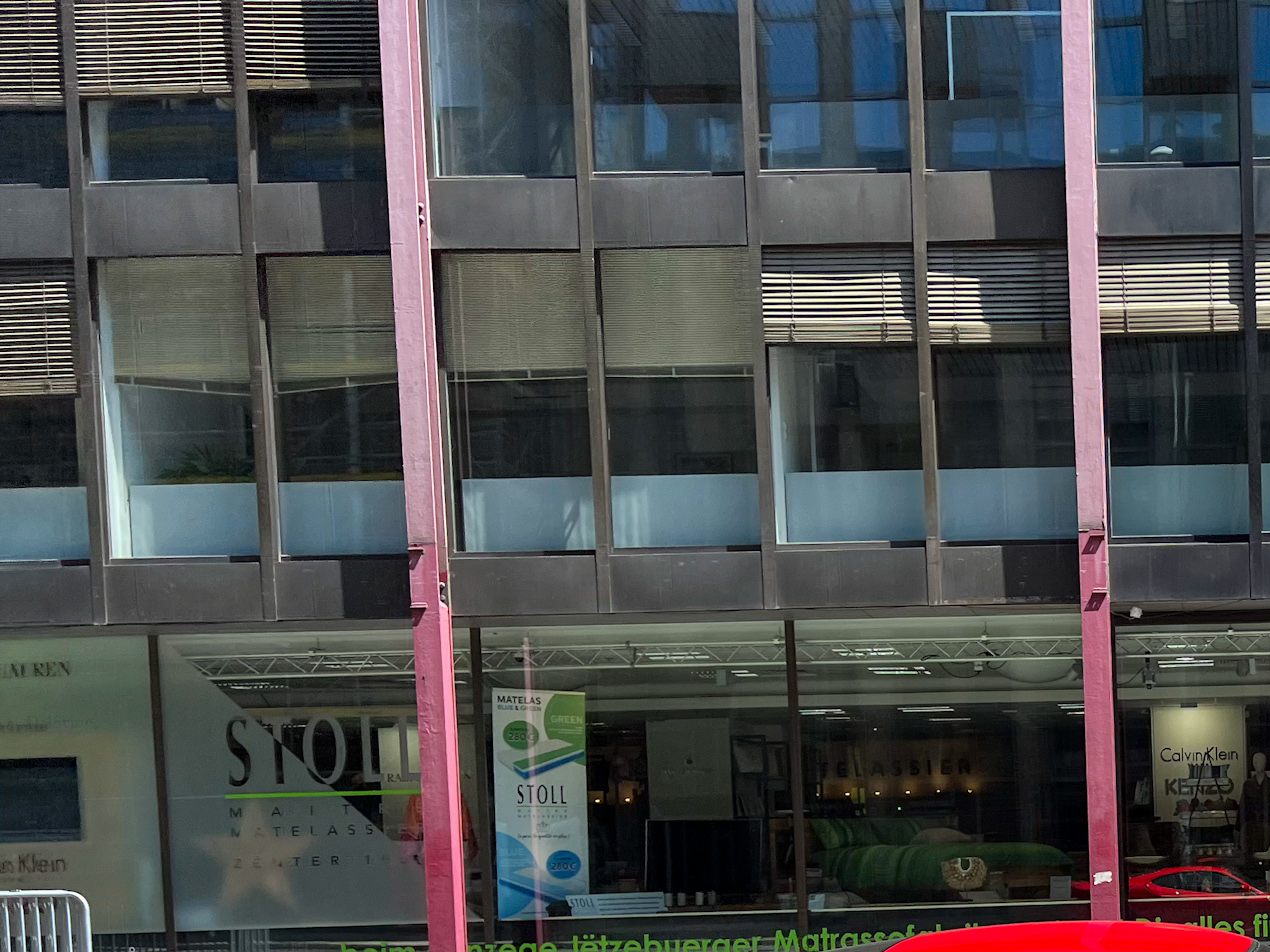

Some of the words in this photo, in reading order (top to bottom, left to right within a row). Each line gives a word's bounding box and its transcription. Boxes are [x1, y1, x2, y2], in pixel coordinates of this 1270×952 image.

[497, 695, 541, 705] MATELAS
[550, 715, 583, 724] GREEN
[517, 784, 567, 804] STOLL
[569, 898, 595, 908] STOLL
